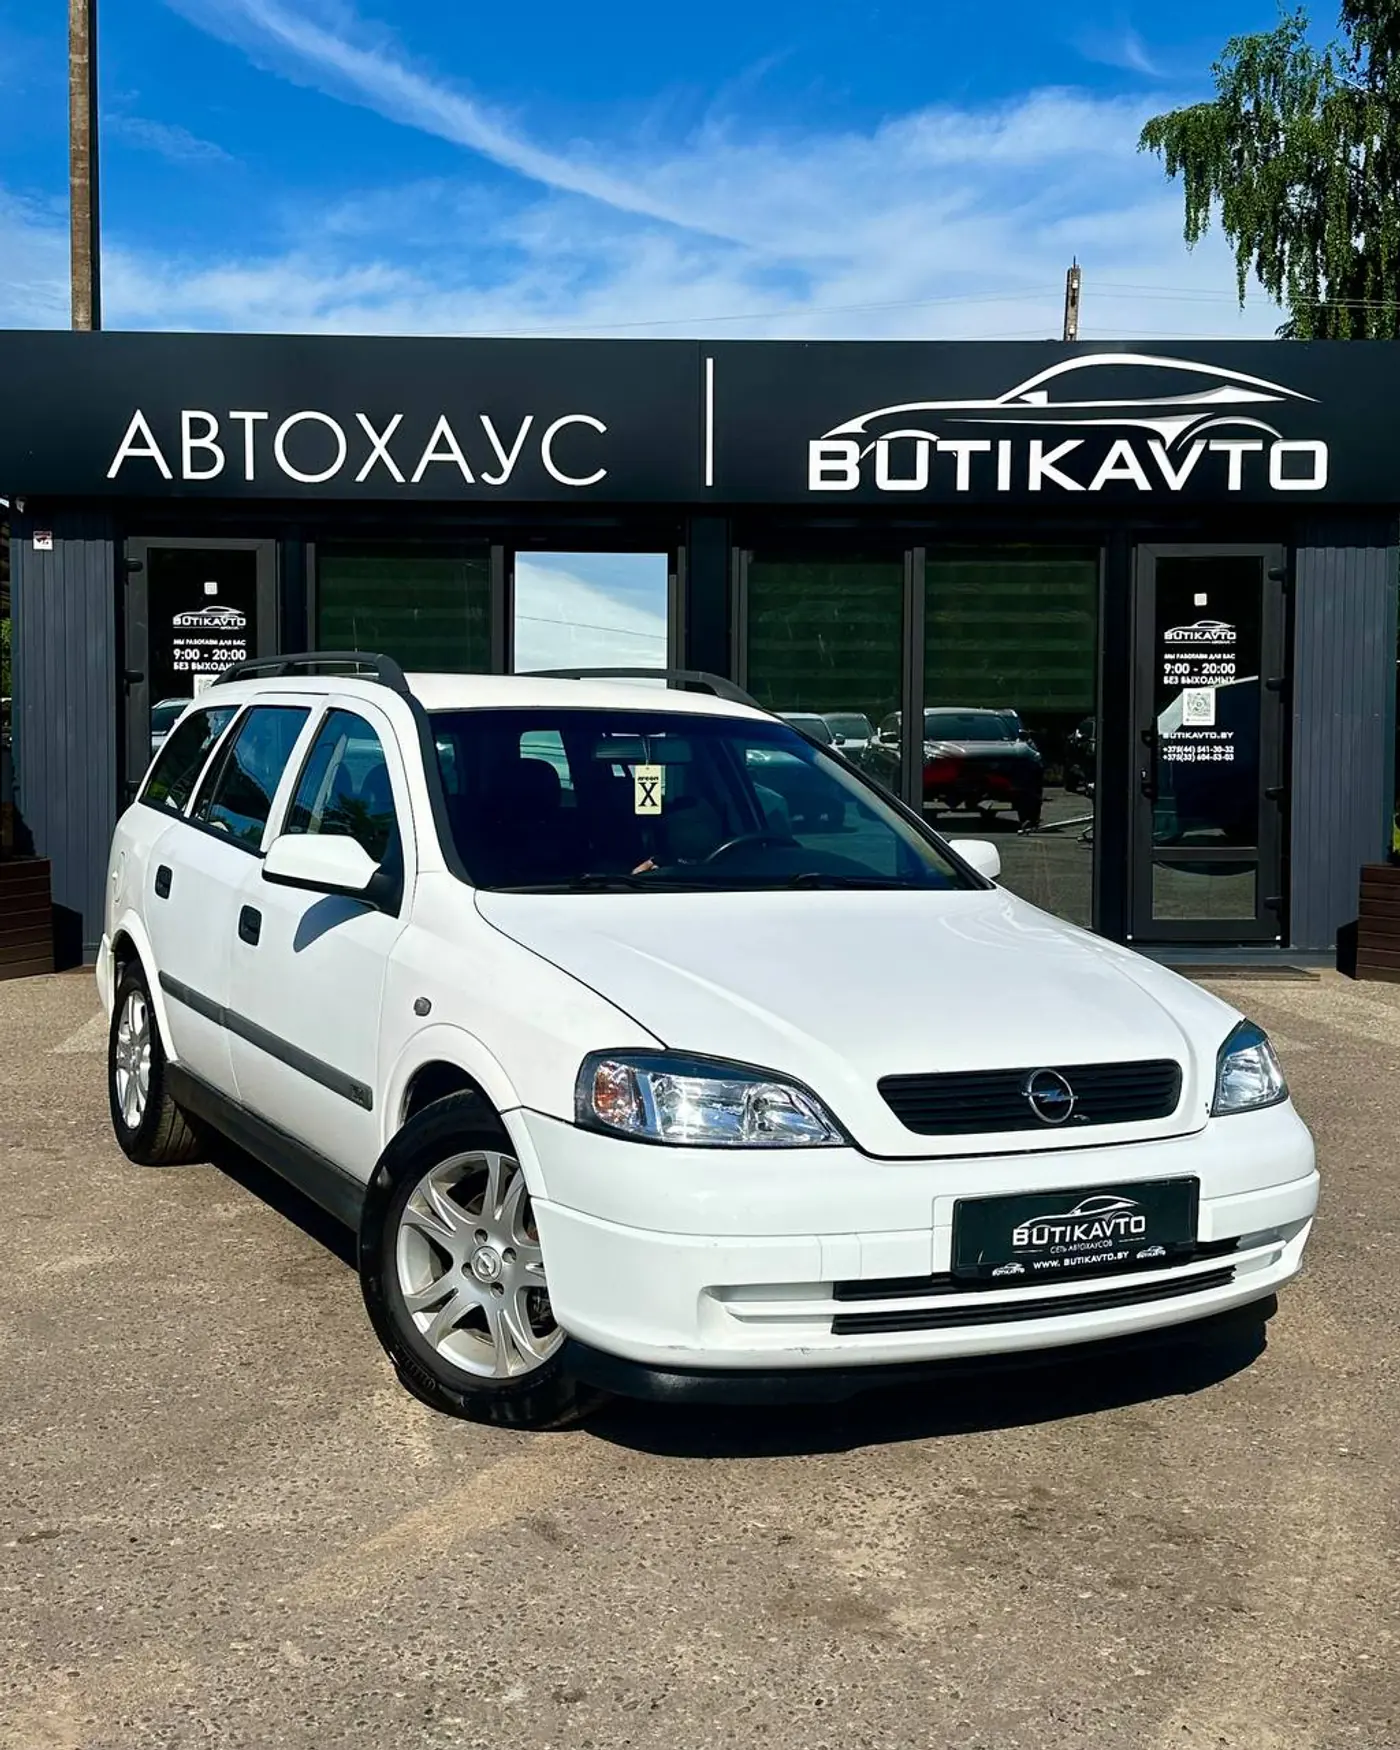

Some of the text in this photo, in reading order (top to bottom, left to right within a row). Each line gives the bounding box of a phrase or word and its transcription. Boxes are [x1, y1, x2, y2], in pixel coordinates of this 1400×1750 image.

[106, 408, 608, 486] АВТОХАУС
[808, 438, 1329, 491] BUTIKAVTO
[172, 617, 247, 626] BUTIKAVTO
[1163, 631, 1237, 640] BUTIKAVTO
[173, 648, 200, 661] 9:00
[212, 649, 247, 661] 20:00
[173, 661, 189, 671] БЕЗ
[1163, 662, 1190, 675] 9:00
[1201, 662, 1236, 675] 20:00
[1163, 675, 1179, 685] БЕЗ
[638, 782, 659, 807] X
[1012, 1215, 1146, 1246] BUTIKAVTO
[1033, 1250, 1130, 1270] WWW. BUTIKAVTO.BY
